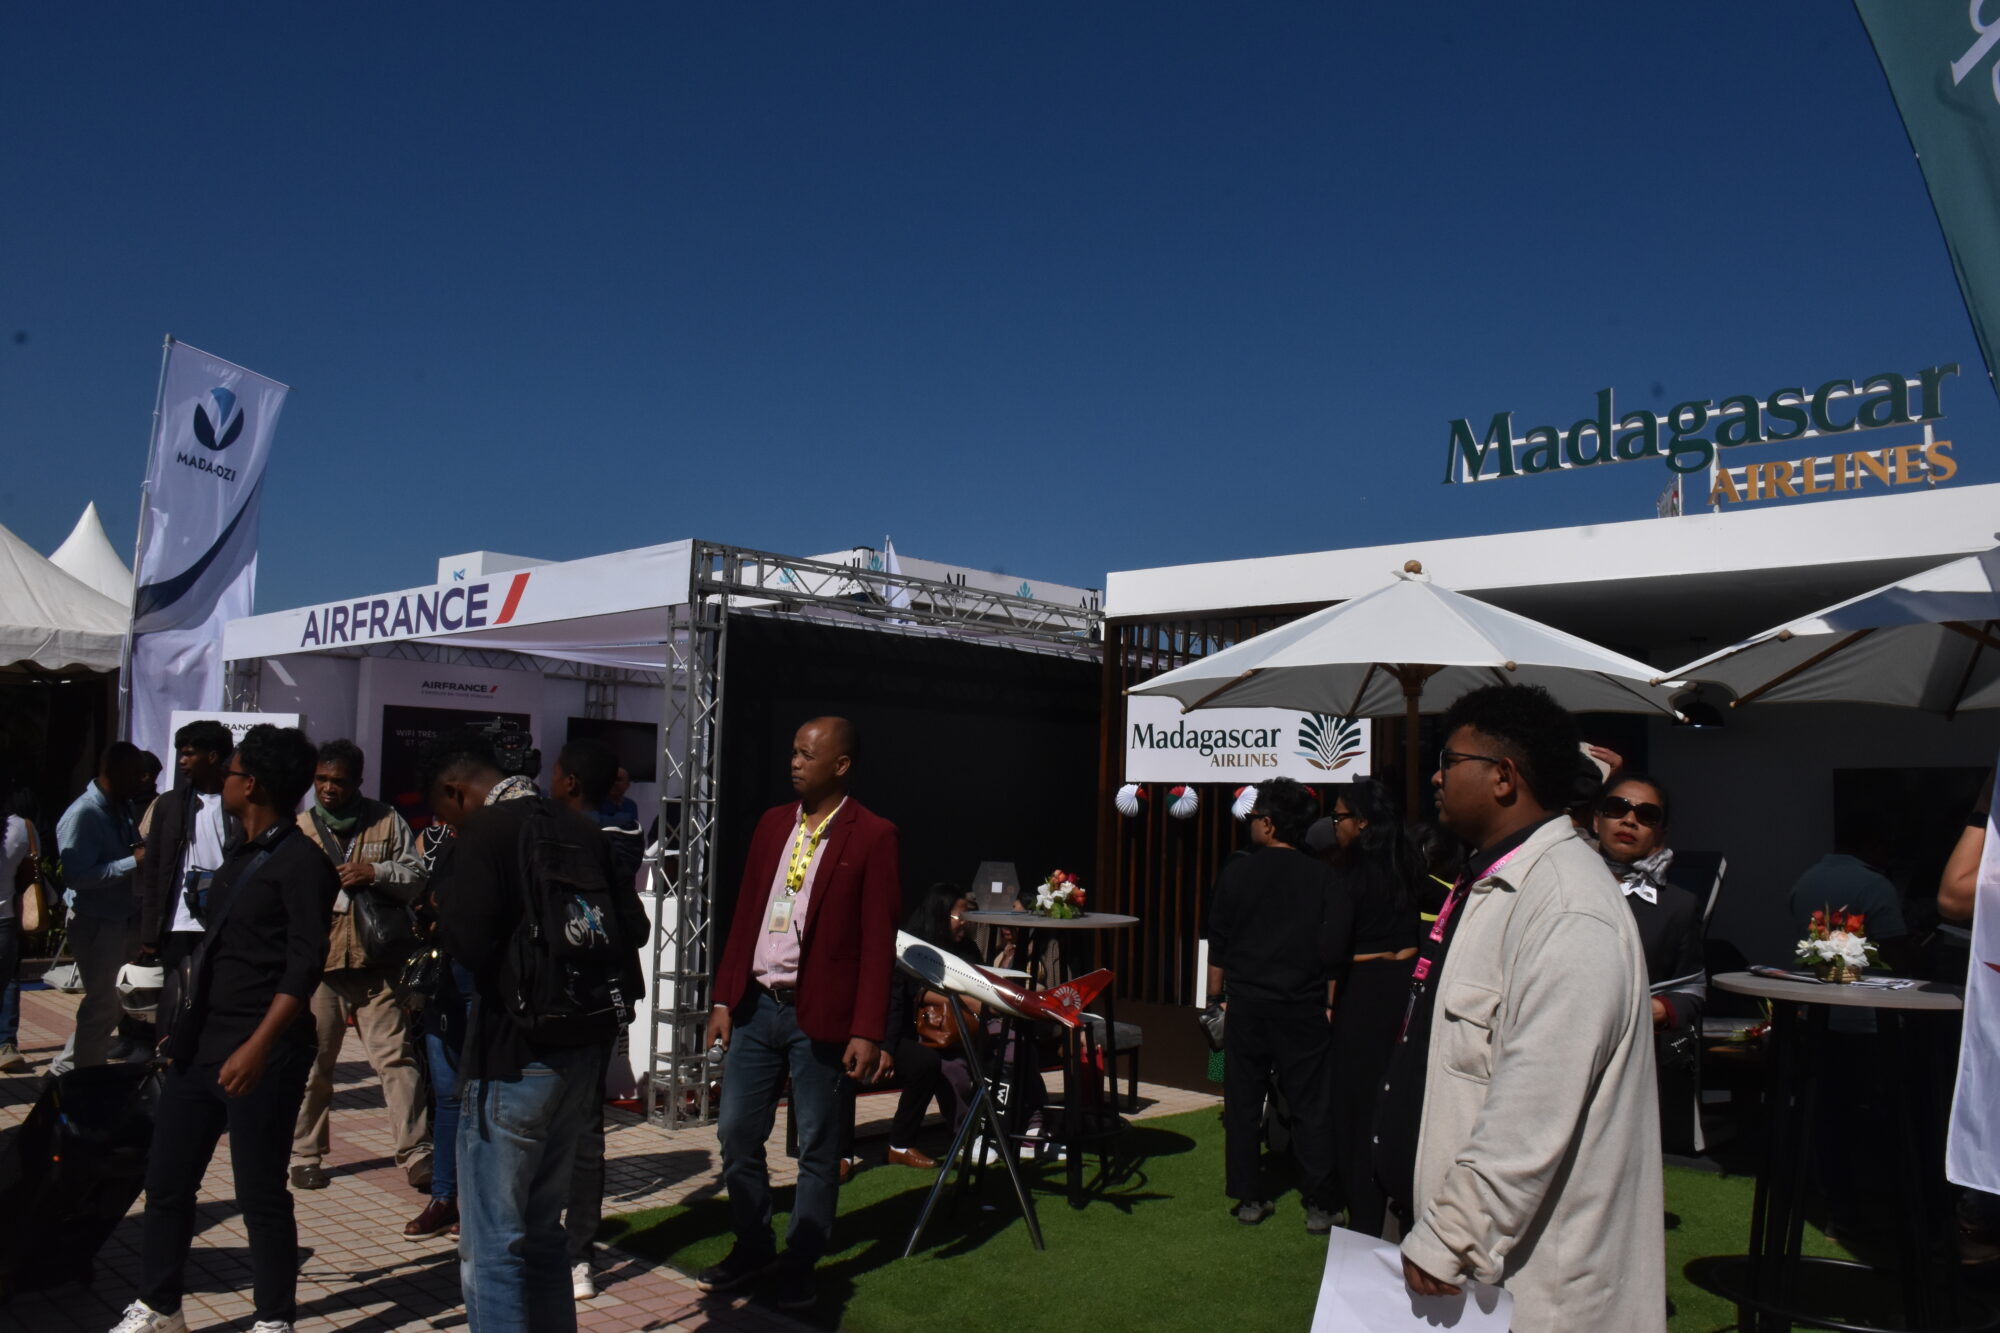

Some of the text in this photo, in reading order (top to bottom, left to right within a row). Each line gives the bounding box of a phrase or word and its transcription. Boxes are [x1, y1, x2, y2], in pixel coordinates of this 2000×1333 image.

[1440, 362, 1960, 485] Madagascar
[176, 451, 237, 482] MADA-OZI
[1707, 440, 1958, 505] AIRLINES
[300, 583, 489, 647] AIRFRANCE
[422, 681, 488, 693] AIRFRANCE
[395, 728, 415, 737] WIFI
[1131, 720, 1282, 757] Madagascar
[1210, 753, 1278, 767] AIRLINES
